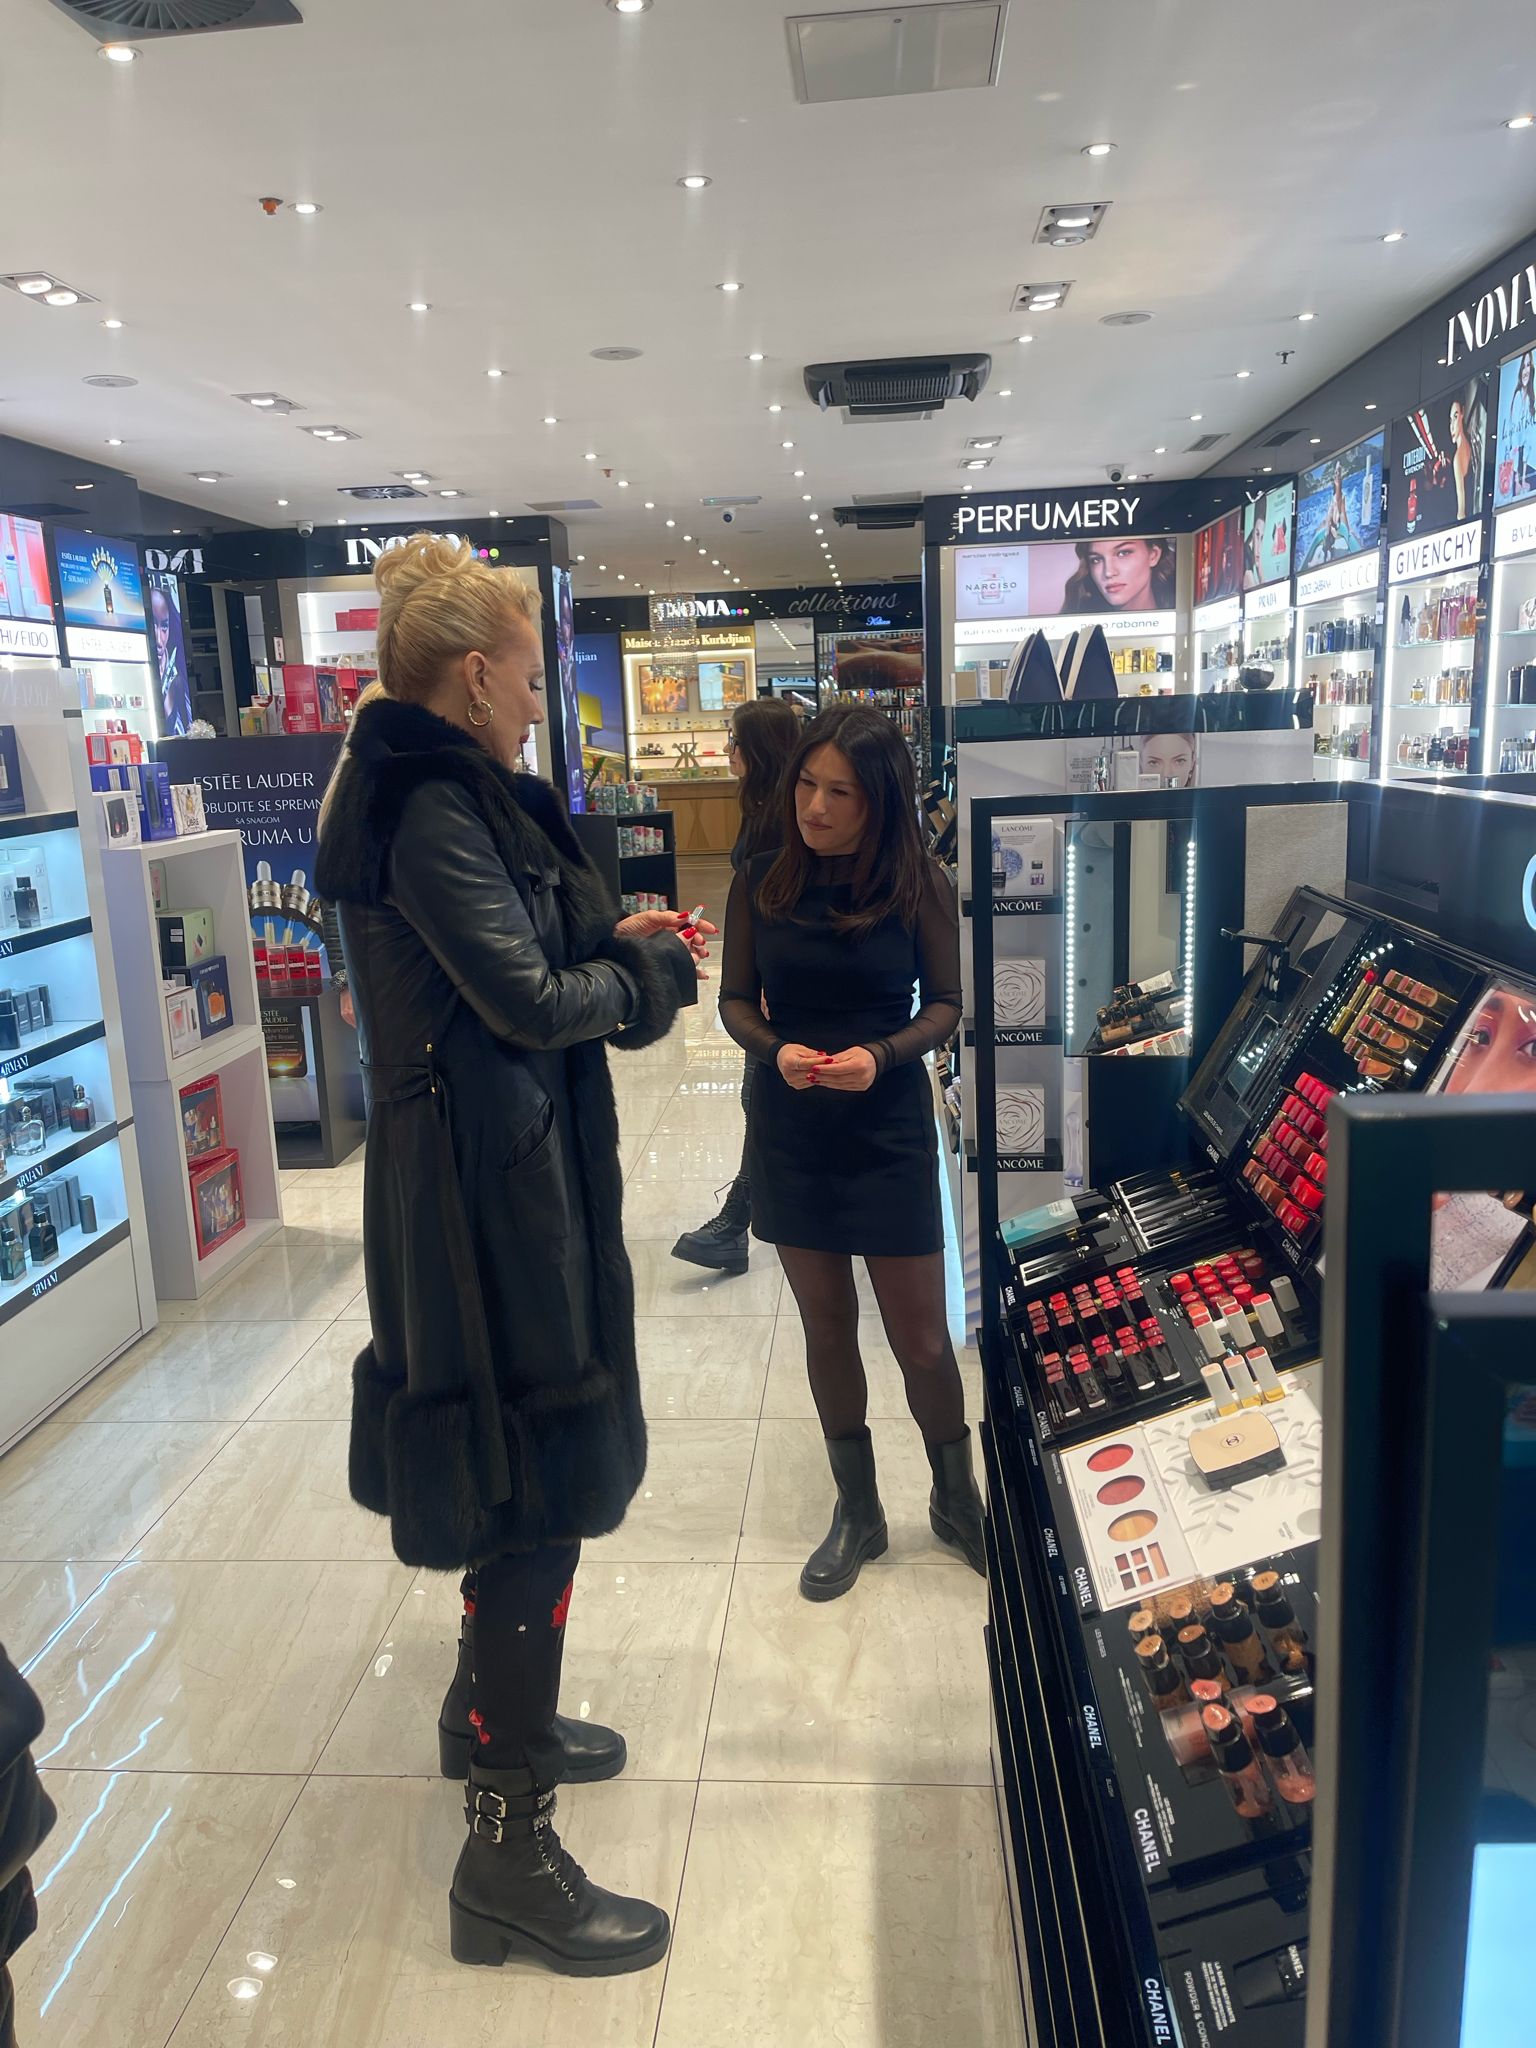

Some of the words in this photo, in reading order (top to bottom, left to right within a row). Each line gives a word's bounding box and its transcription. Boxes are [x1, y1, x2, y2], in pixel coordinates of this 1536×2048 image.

[957, 497, 1141, 534] PERFUMERY
[1511, 524, 1536, 543] BVL
[1396, 529, 1477, 575] GIVENCHY
[965, 581, 1017, 591] NARCISO
[788, 592, 900, 614] collections
[1081, 622, 1109, 631] pao
[1112, 619, 1160, 629] rabanne
[0, 628, 48, 648] HISEIDO
[701, 634, 752, 651] Kurkdjian
[246, 772, 314, 789] LAUDER
[203, 801, 254, 814] OBUDITE
[258, 801, 271, 812] SE
[276, 799, 323, 811] SPREMN
[236, 817, 245, 825] SA
[247, 816, 280, 825] SNAGOM
[240, 829, 293, 846] RUMA
[299, 828, 312, 844] U
[992, 900, 1042, 912] ANCÔME
[263, 1016, 289, 1024] AUDER
[994, 1031, 1043, 1042] ANCÔME
[997, 1158, 1044, 1169] ANCÔME
[1281, 1238, 1300, 1265] CHANEL
[1004, 1286, 1016, 1306] CHANEL
[1013, 1386, 1025, 1407] CHANEL
[1037, 1410, 1051, 1439] CHANEL
[1043, 1527, 1058, 1558] CHANEL
[1074, 1566, 1093, 1607] CHANEL
[1083, 1704, 1102, 1749] CHANEL
[1134, 1807, 1161, 1874] CHANEL
[1183, 1970, 1200, 2012] POWDER
[1144, 1977, 1172, 2046] CHANEL
